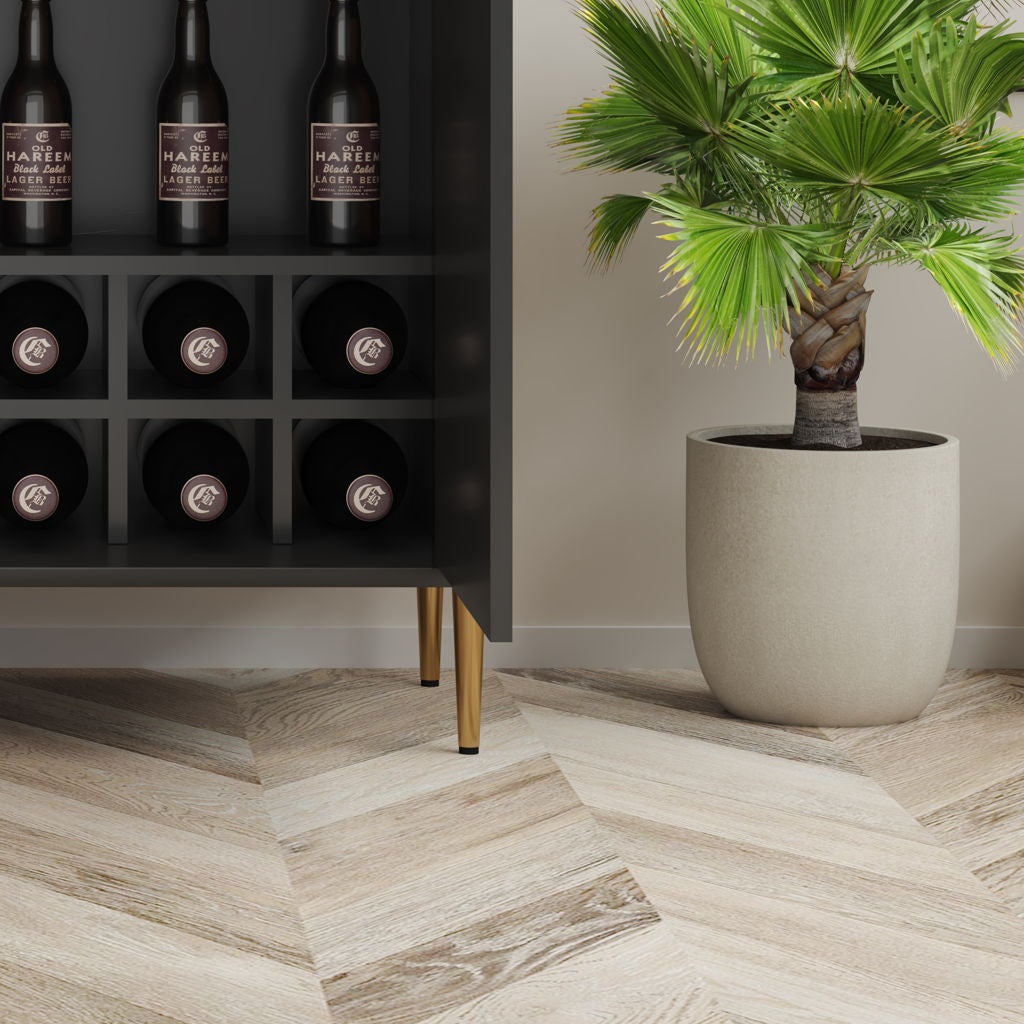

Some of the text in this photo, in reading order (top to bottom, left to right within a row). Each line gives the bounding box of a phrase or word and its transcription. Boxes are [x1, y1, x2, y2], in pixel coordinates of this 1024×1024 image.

[7, 151, 72, 162] HAREEM
[164, 151, 228, 162] HAREEM
[13, 163, 39, 173] Black
[171, 163, 197, 173] Black
[323, 163, 349, 173] Black
[6, 175, 43, 184] LAGER
[163, 175, 201, 184] LAGER
[316, 175, 353, 184] LAGER
